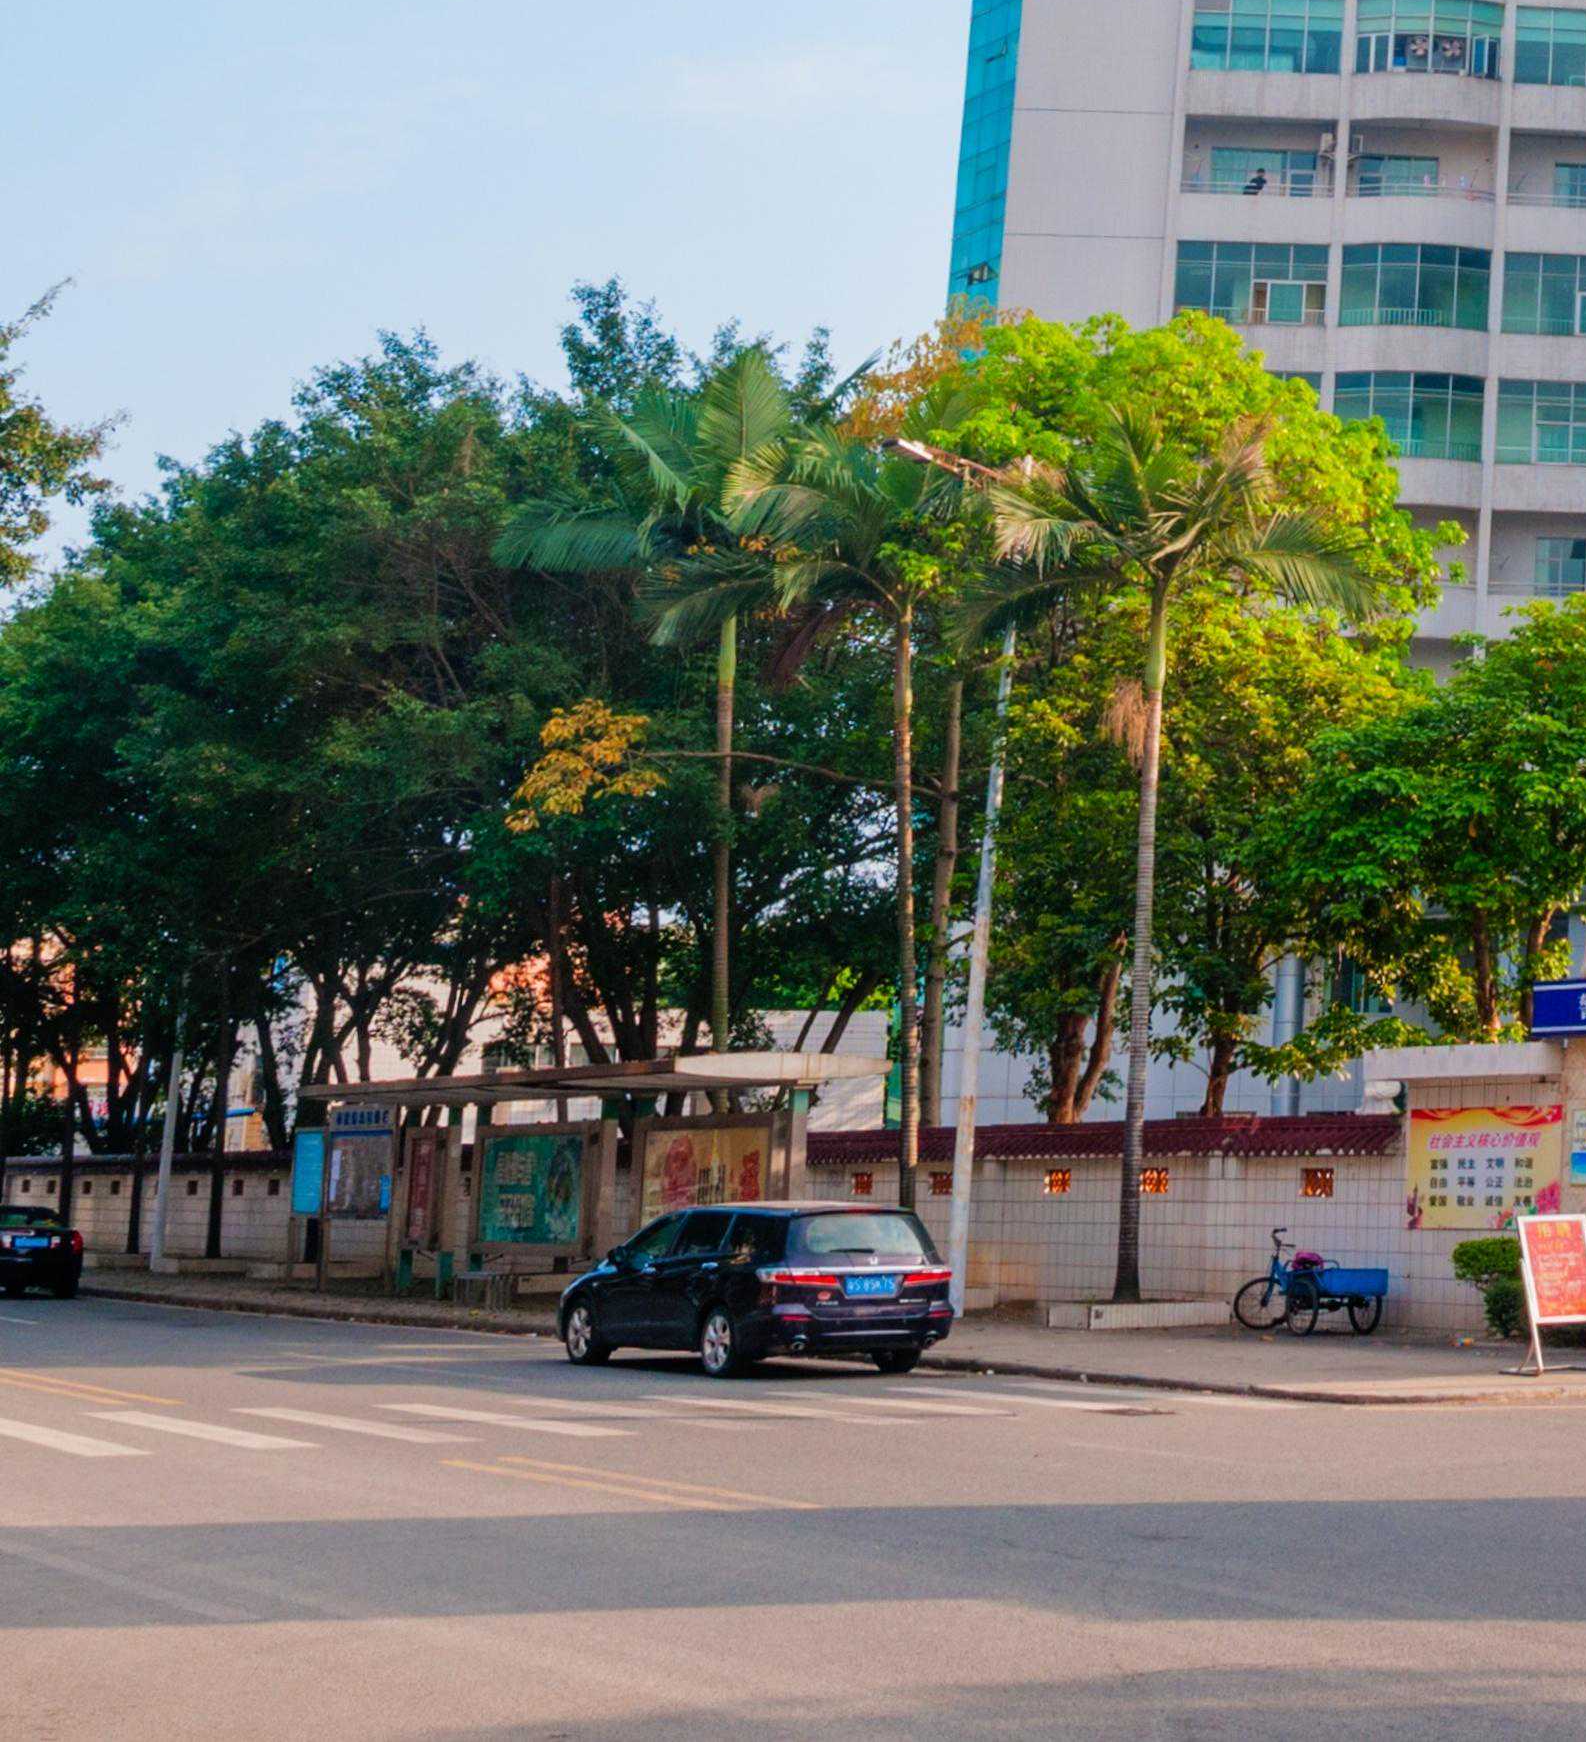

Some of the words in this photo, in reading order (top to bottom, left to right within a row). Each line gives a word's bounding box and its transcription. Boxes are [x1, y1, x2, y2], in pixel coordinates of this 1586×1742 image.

[1428, 1131, 1541, 1150] 社会主义核心价值观
[1430, 1159, 1448, 1170] 富强
[1457, 1159, 1476, 1170] 民主
[1485, 1158, 1505, 1169] 文明
[1430, 1176, 1448, 1188] 自由
[1457, 1176, 1475, 1188] 平等
[1485, 1176, 1504, 1188] 公正
